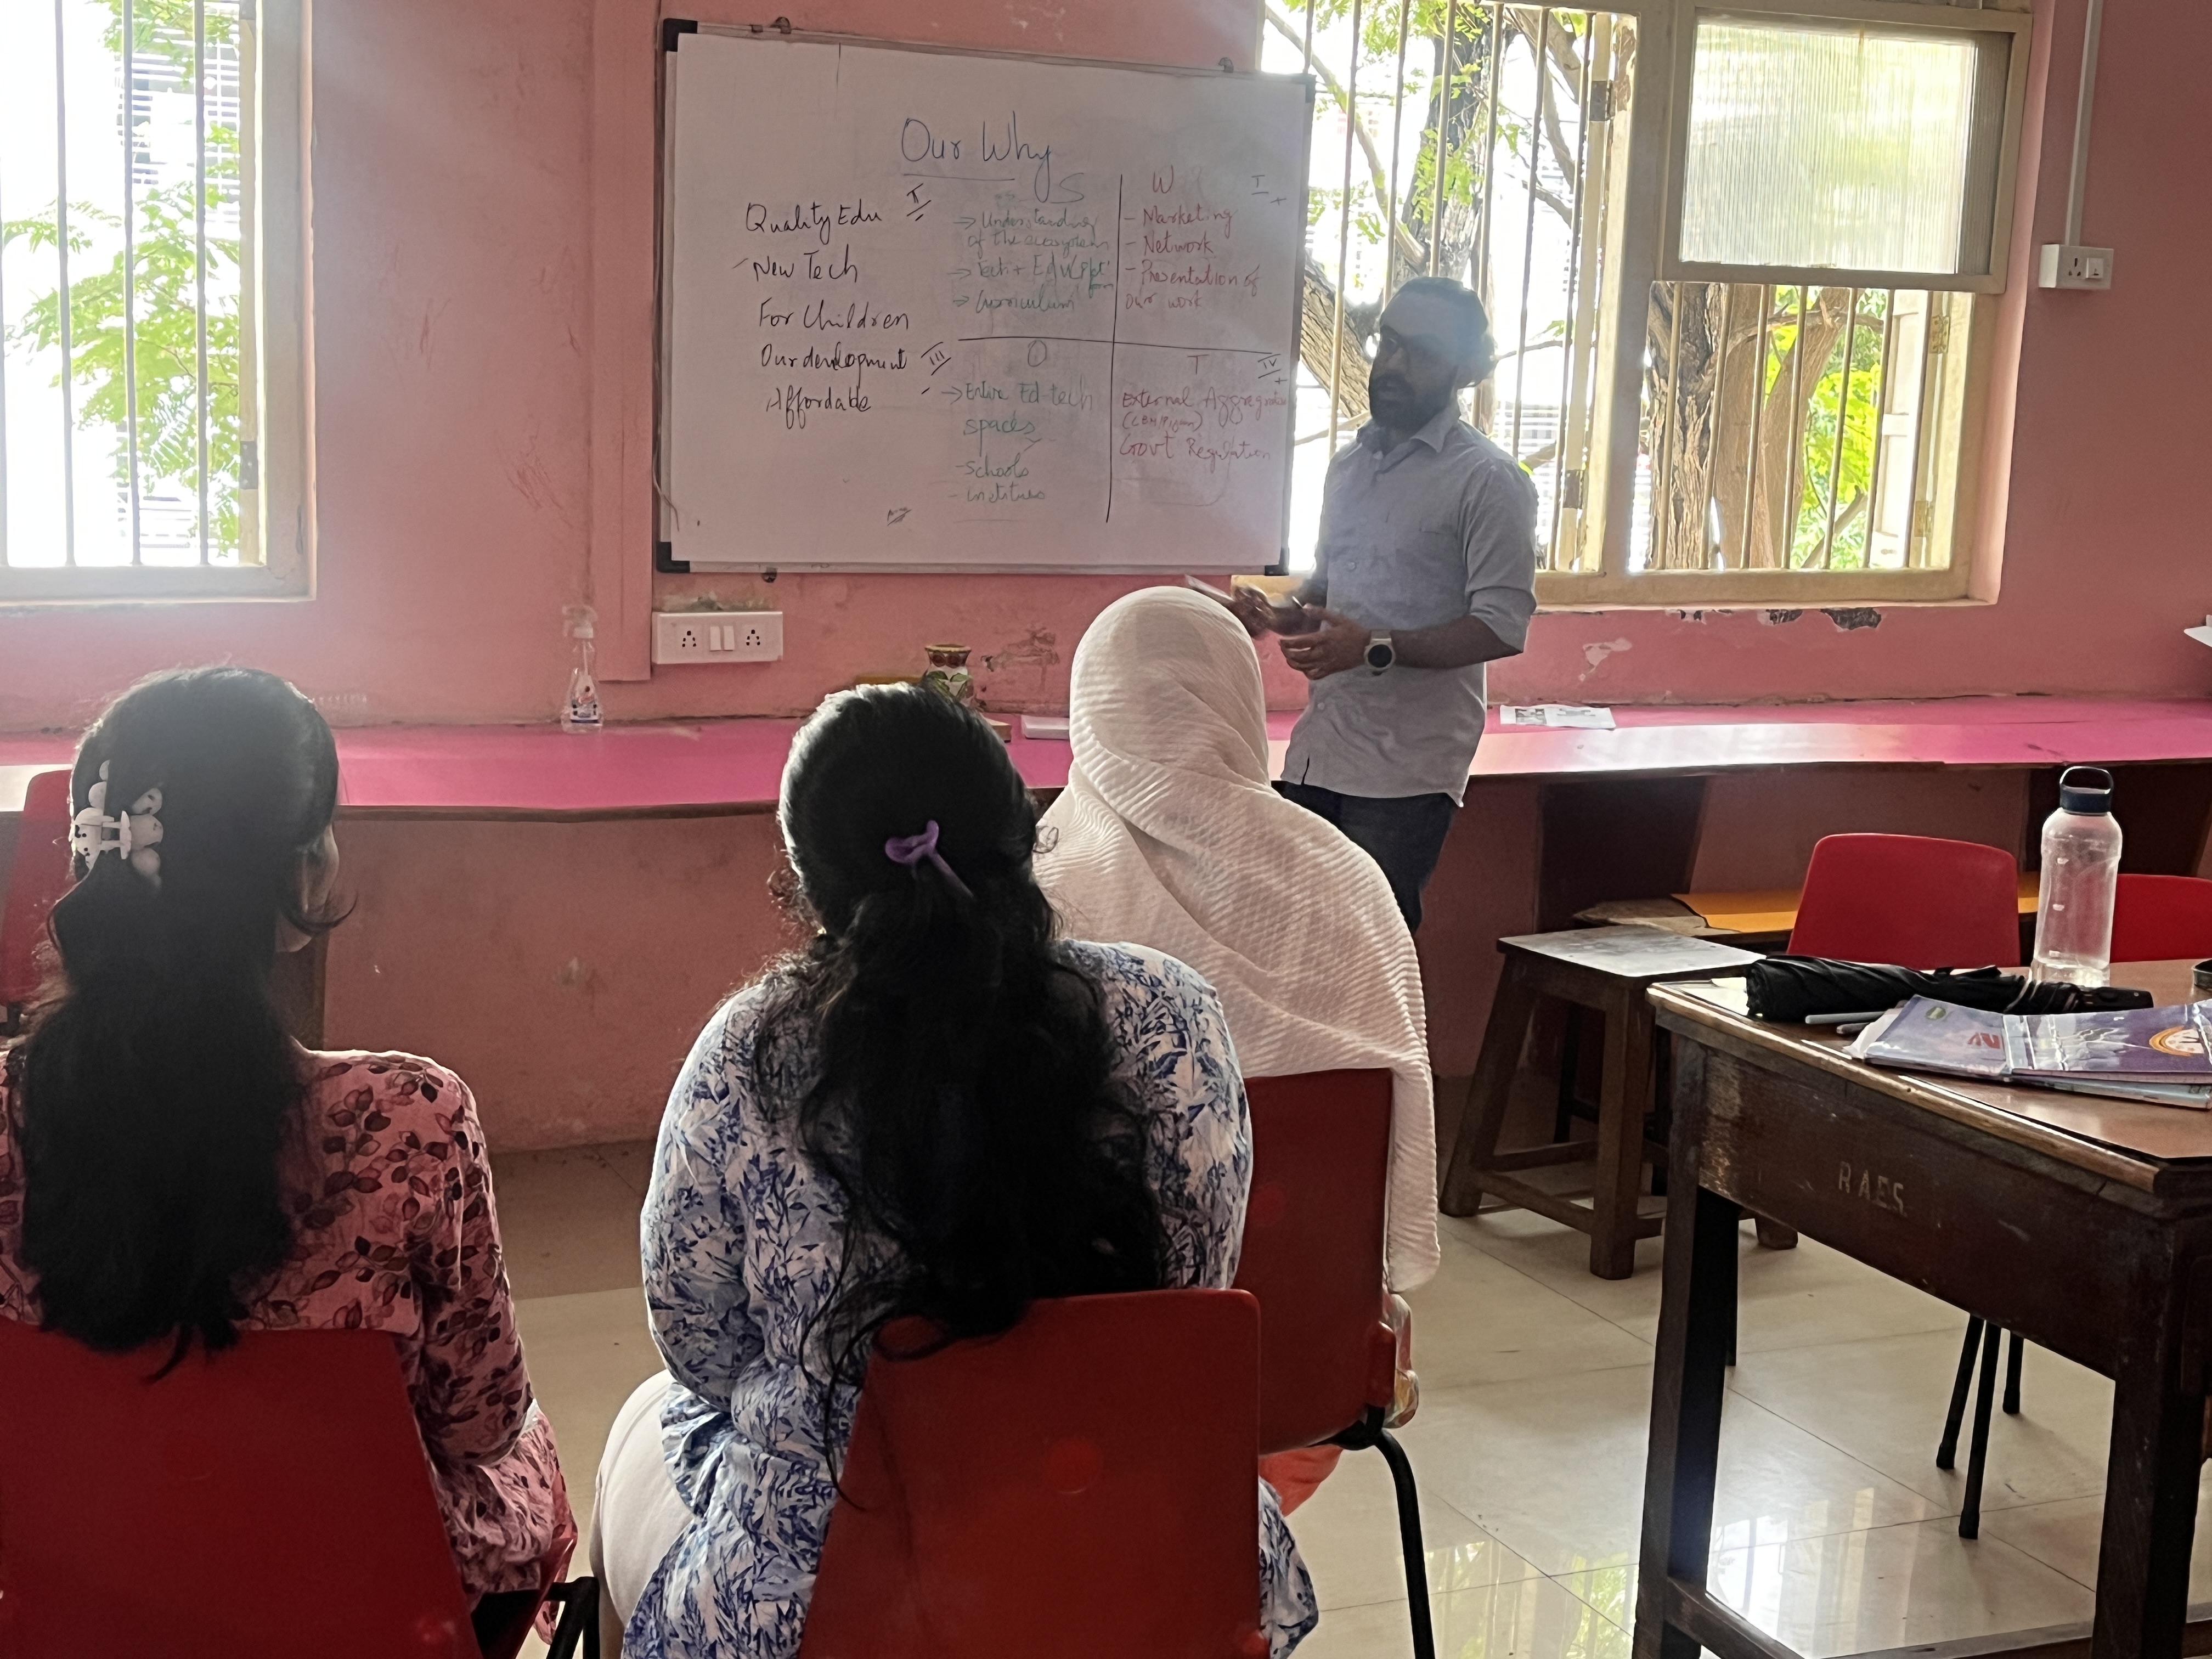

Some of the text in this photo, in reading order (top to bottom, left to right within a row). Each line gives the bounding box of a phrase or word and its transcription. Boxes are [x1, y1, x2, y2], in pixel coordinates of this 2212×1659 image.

[901, 110, 1052, 203] Our Why
[1049, 172, 1085, 204] S
[1153, 164, 1174, 194] W
[746, 198, 883, 245] Quality Edu
[1143, 203, 1237, 239] Marketing
[968, 228, 986, 259] of
[1143, 230, 1215, 256] Network
[753, 243, 857, 283] New Tech
[1141, 259, 1261, 297] Presentation of
[760, 297, 909, 330] For Children
[1168, 290, 1202, 308] work
[761, 343, 798, 366] Our
[1187, 354, 1209, 375] T
[766, 384, 872, 428] Affordable
[1122, 385, 1193, 408] External
